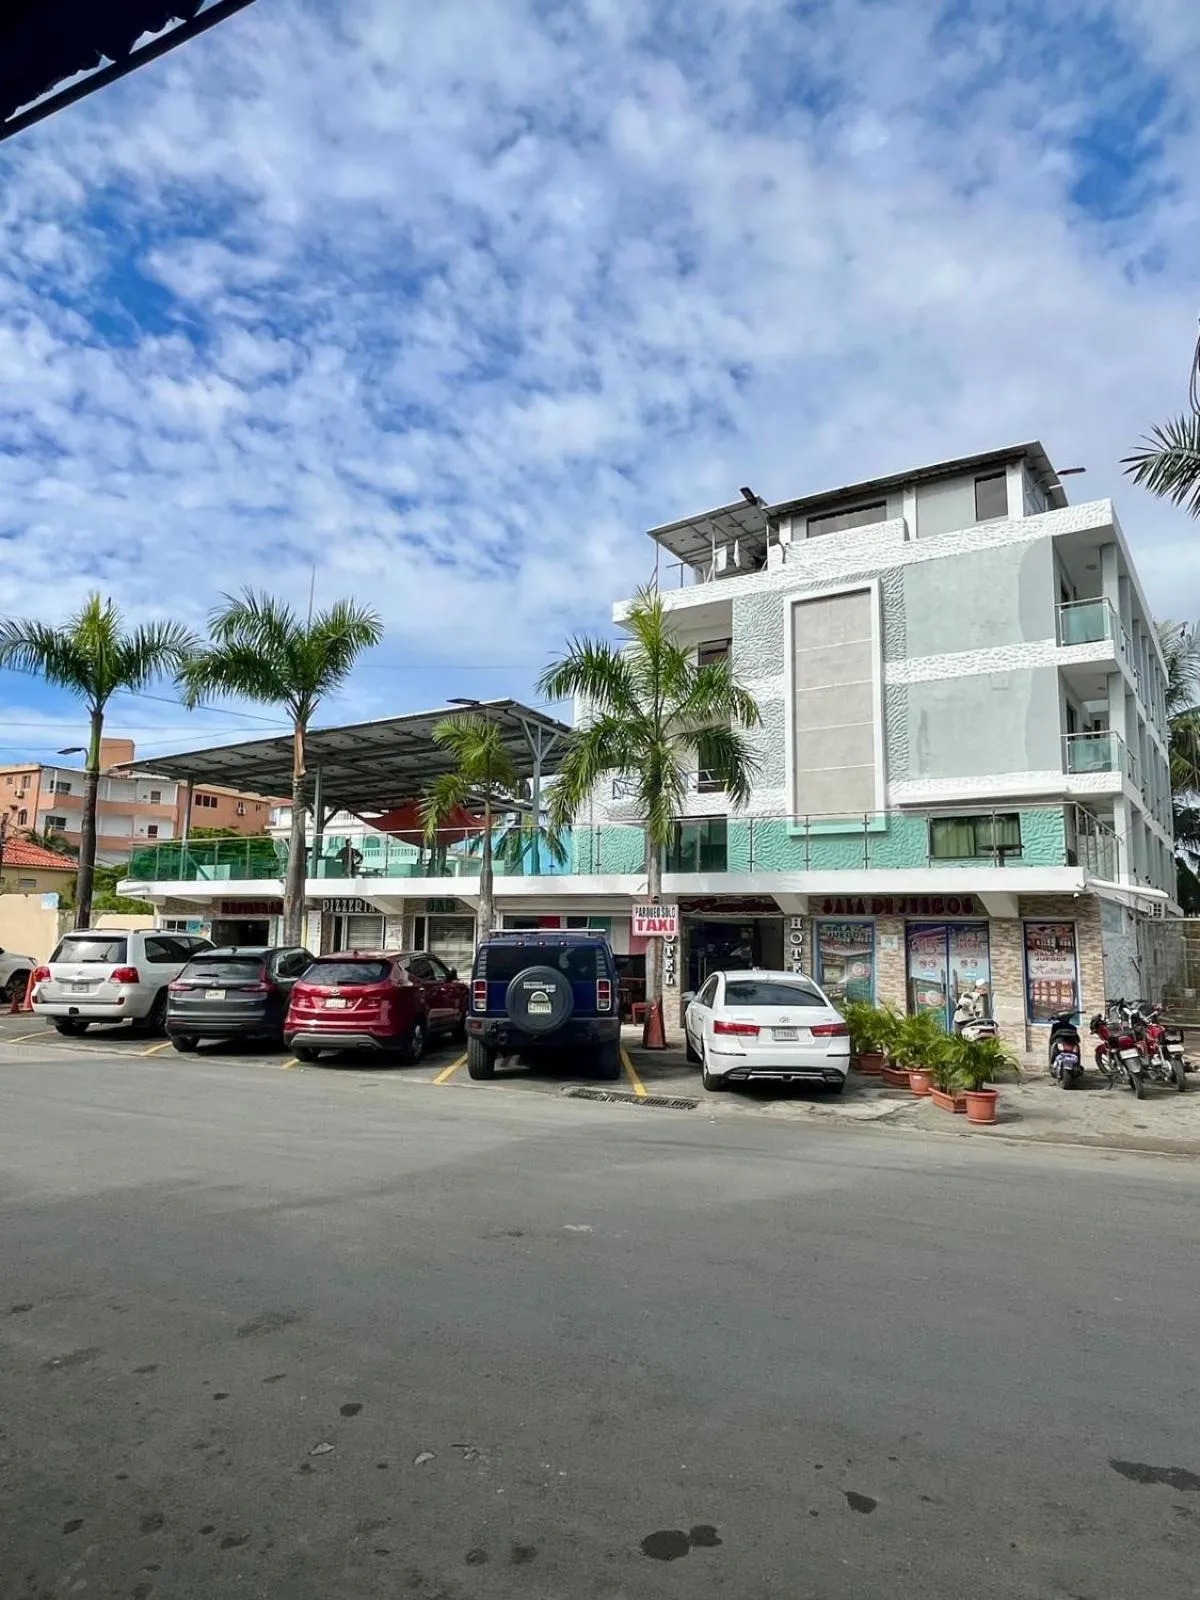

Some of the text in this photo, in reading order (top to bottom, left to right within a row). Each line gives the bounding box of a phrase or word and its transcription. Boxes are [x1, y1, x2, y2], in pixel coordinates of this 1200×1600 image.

[322, 898, 376, 913] PIZZERIA
[635, 906, 660, 918] PARQUEO
[897, 896, 974, 915] JUEGOS
[635, 918, 676, 932] TAXI
[790, 917, 803, 974] HOTE
